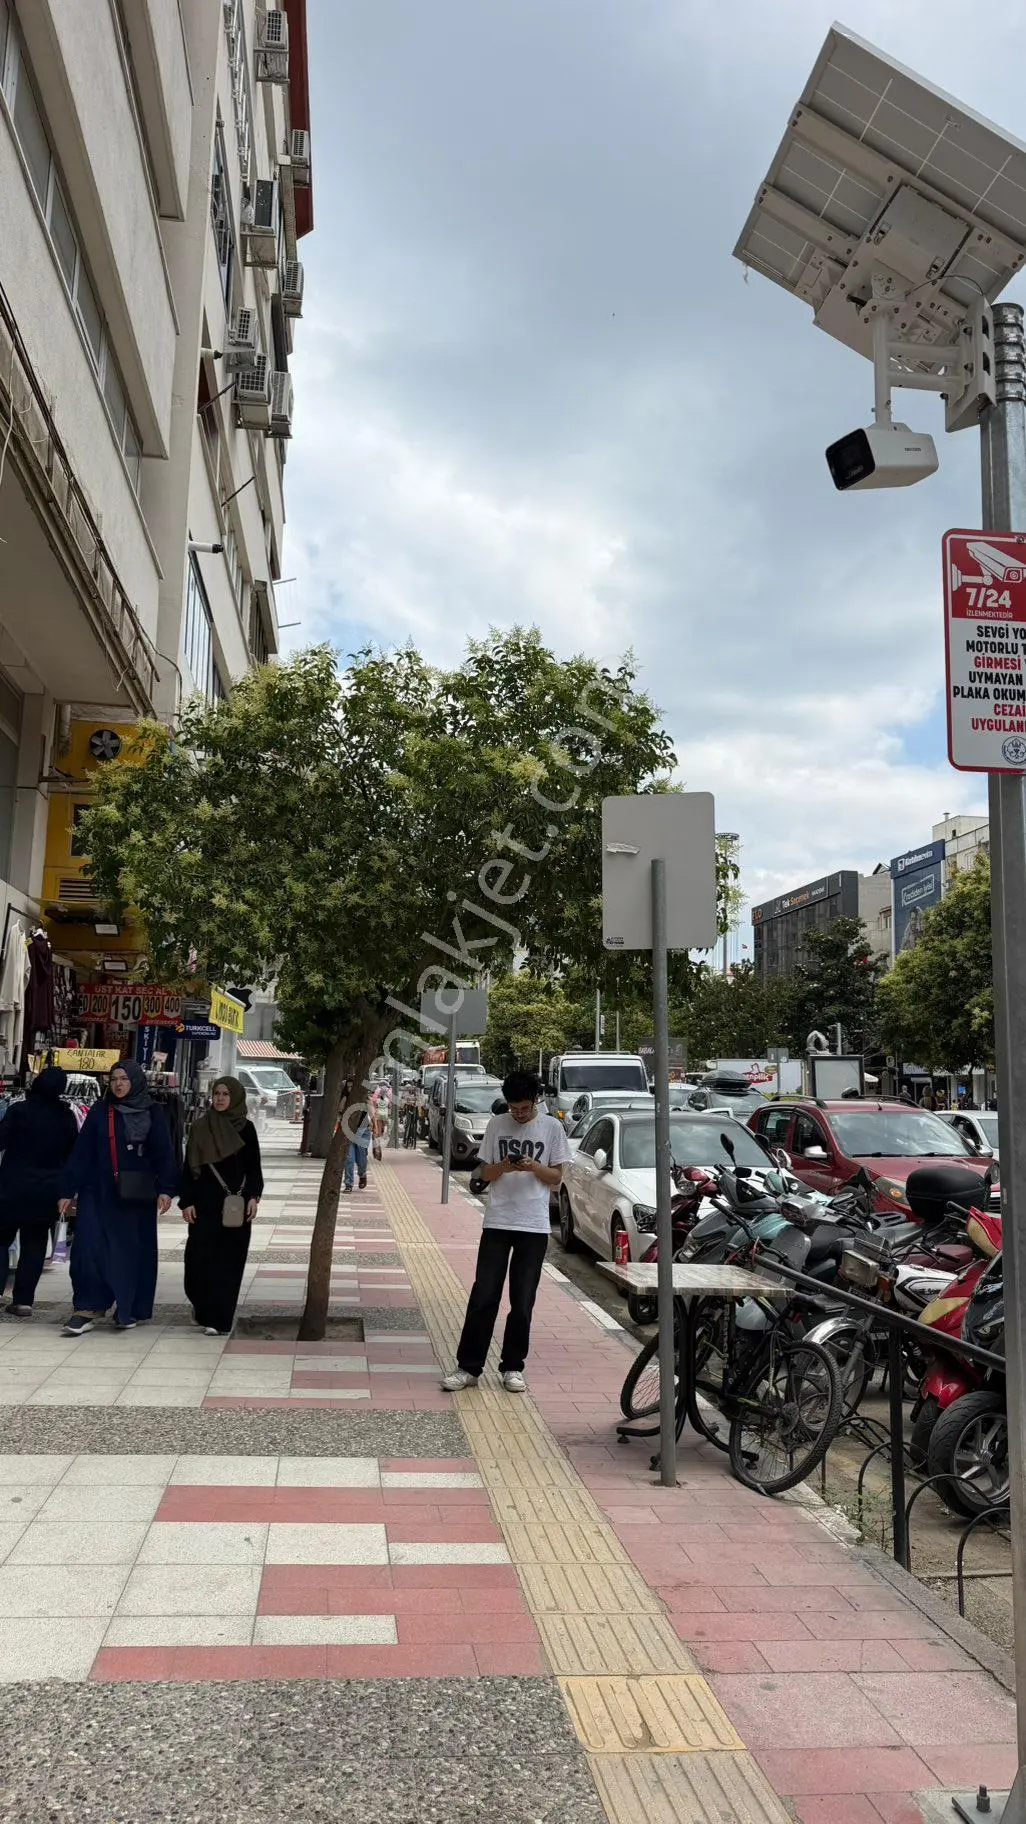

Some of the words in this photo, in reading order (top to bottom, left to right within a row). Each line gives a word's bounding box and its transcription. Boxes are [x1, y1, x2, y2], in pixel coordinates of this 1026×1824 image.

[965, 587, 1012, 609] 7/24
[966, 608, 1013, 619] İZLENMEKTEDİR
[976, 623, 1009, 639] SEVGİ
[1012, 627, 1026, 640] YO
[966, 640, 1019, 655] MOTORLU
[974, 653, 1022, 671] GİRMESİ
[968, 671, 1023, 686] UYMAYAN
[953, 686, 990, 699] PLAKA
[993, 687, 1026, 702] OKUM
[92, 995, 108, 1013] 200
[111, 995, 142, 1020] 150
[144, 996, 161, 1012] 300
[164, 997, 180, 1012] 400
[77, 1057, 95, 1070] 180
